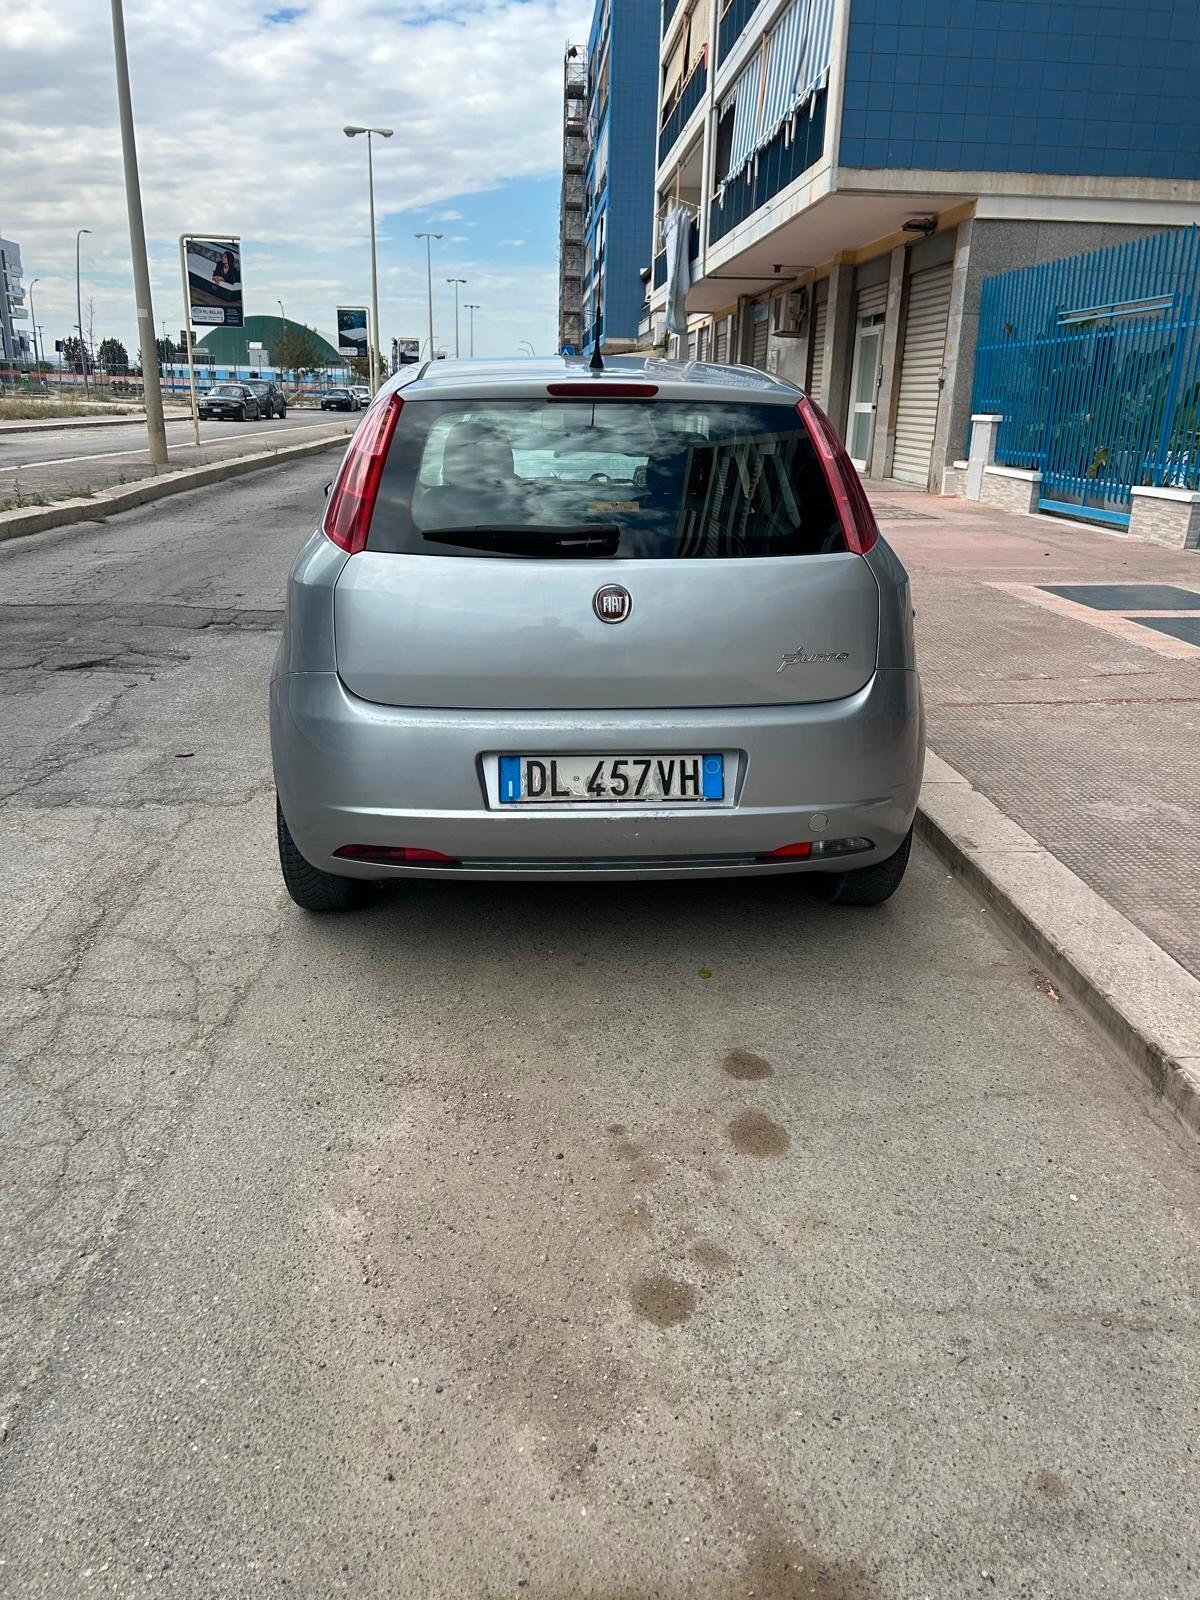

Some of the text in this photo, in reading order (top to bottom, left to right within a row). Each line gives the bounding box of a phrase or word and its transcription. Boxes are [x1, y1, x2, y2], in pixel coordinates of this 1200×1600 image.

[603, 596, 624, 613] FIAT
[526, 760, 570, 797] DL
[587, 759, 700, 797] 457VH
